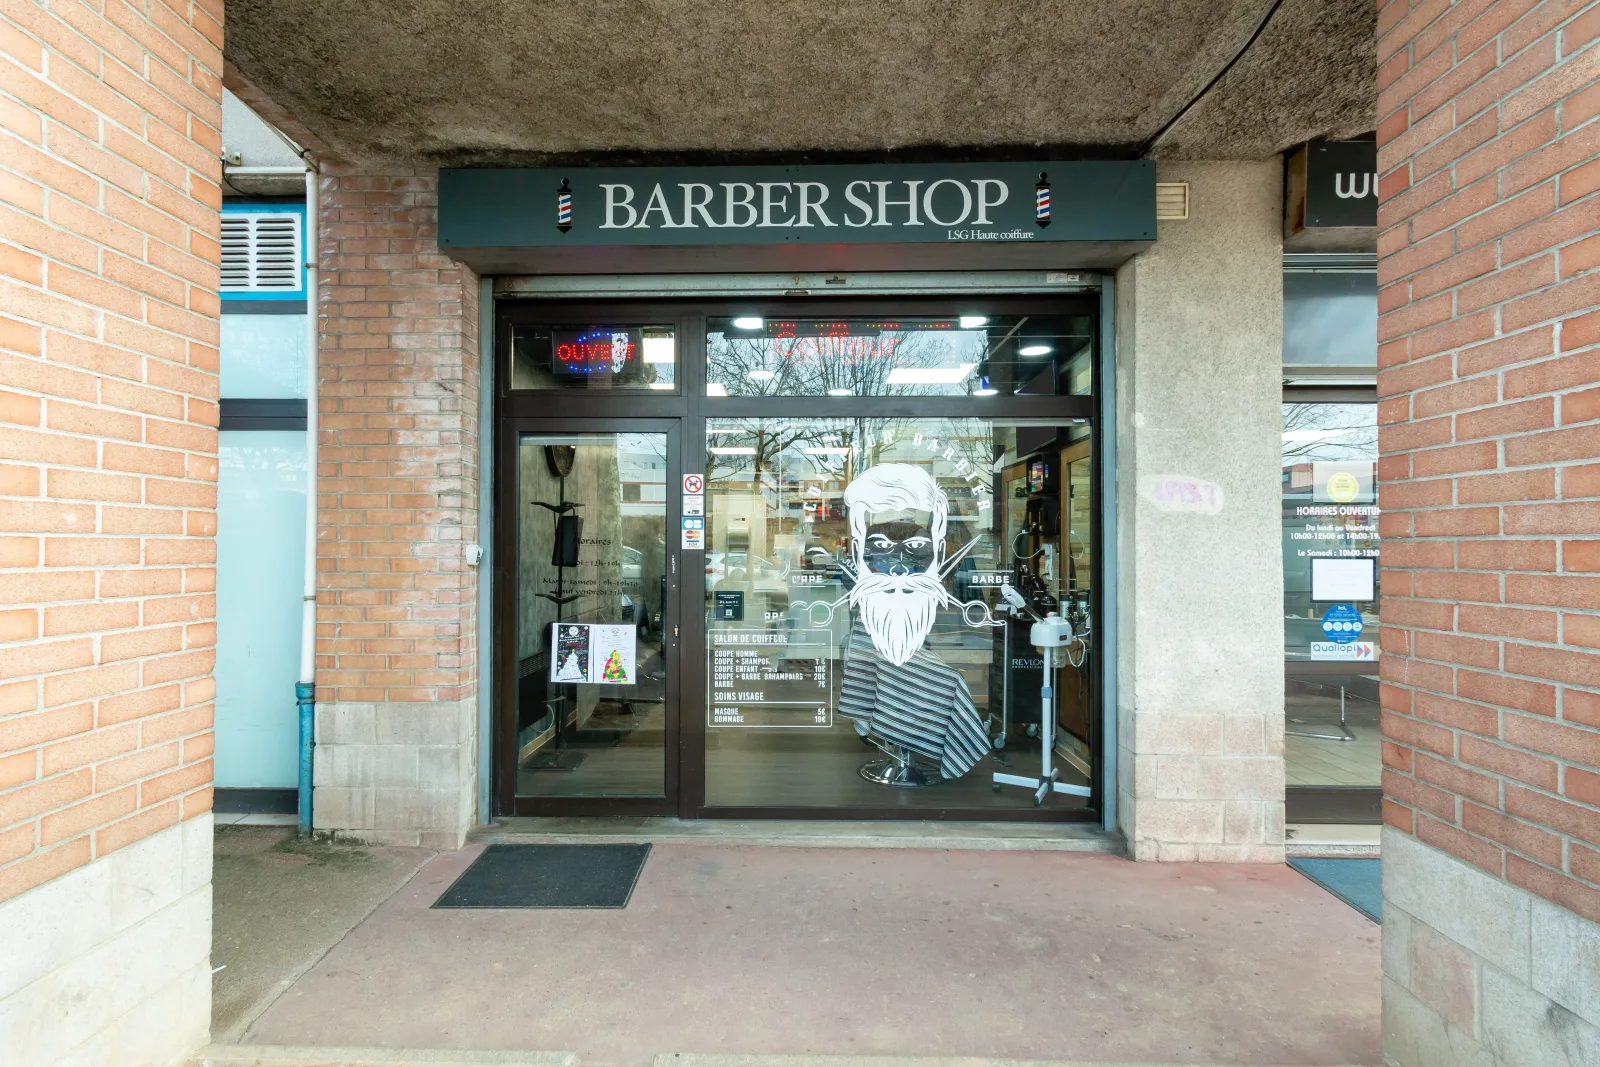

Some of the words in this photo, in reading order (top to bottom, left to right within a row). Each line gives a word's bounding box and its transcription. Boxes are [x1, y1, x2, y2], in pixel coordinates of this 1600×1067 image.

[598, 182, 838, 229] BARBER
[844, 178, 1009, 228] SHOP
[947, 229, 969, 240] LSG
[970, 229, 999, 240] Haute
[999, 228, 1035, 239] coiffure
[1296, 506, 1338, 516] HORAIRES
[1305, 524, 1316, 532] Du
[1316, 523, 1334, 532] lundi
[1345, 524, 1376, 532] Vendredi
[576, 537, 612, 545] oraires
[1297, 549, 1306, 557] Le
[1306, 549, 1333, 557] Samedi
[972, 575, 1010, 584] BARBE
[714, 634, 738, 643] SALON
[739, 634, 750, 643] DE
[1312, 643, 1356, 654] Qualiopi
[714, 650, 734, 658] COUPE
[735, 650, 758, 658] HOMME
[714, 658, 734, 666] COUPE
[814, 665, 826, 673] 10€
[714, 673, 734, 681] COUPE
[741, 673, 761, 681] BARBE
[813, 673, 826, 681] 20€
[714, 680, 734, 688] BARBE
[817, 680, 826, 688] 7€
[714, 692, 736, 701] SOINS
[738, 692, 764, 701] VISAGE
[714, 708, 739, 716] MASQUE
[817, 708, 826, 716] 5€
[714, 715, 744, 723] GOMMAGE
[814, 715, 826, 723] 10€
